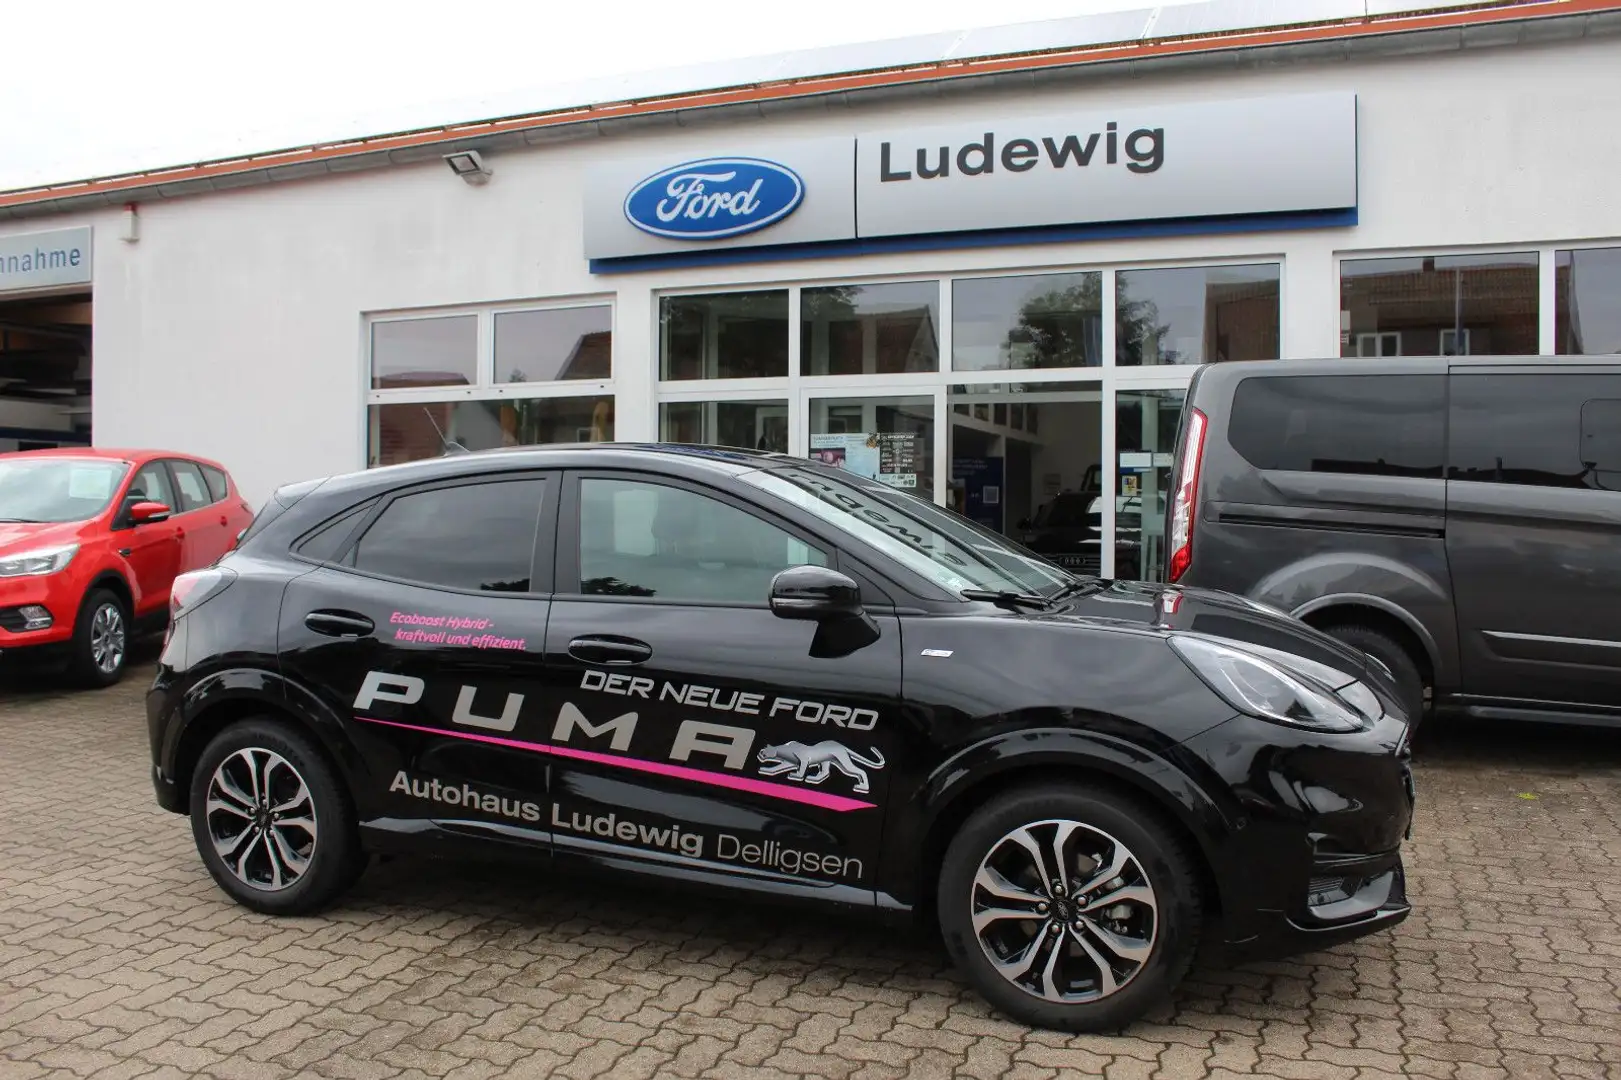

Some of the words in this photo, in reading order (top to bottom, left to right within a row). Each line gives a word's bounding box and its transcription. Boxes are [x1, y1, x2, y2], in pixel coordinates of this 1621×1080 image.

[880, 121, 1165, 183] Ludewig
[656, 171, 761, 220] Ford
[389, 611, 446, 627] Ecoboost
[394, 628, 446, 643] kraftvoll
[447, 634, 472, 646] und
[471, 635, 527, 651] effizient.
[353, 670, 757, 770] PUMA
[580, 669, 655, 699] DER
[659, 681, 765, 714] NEUE
[769, 697, 879, 731] FORD
[388, 770, 541, 823] Autohaus
[550, 802, 704, 858] Ludewig
[716, 833, 864, 880] Delligsen
